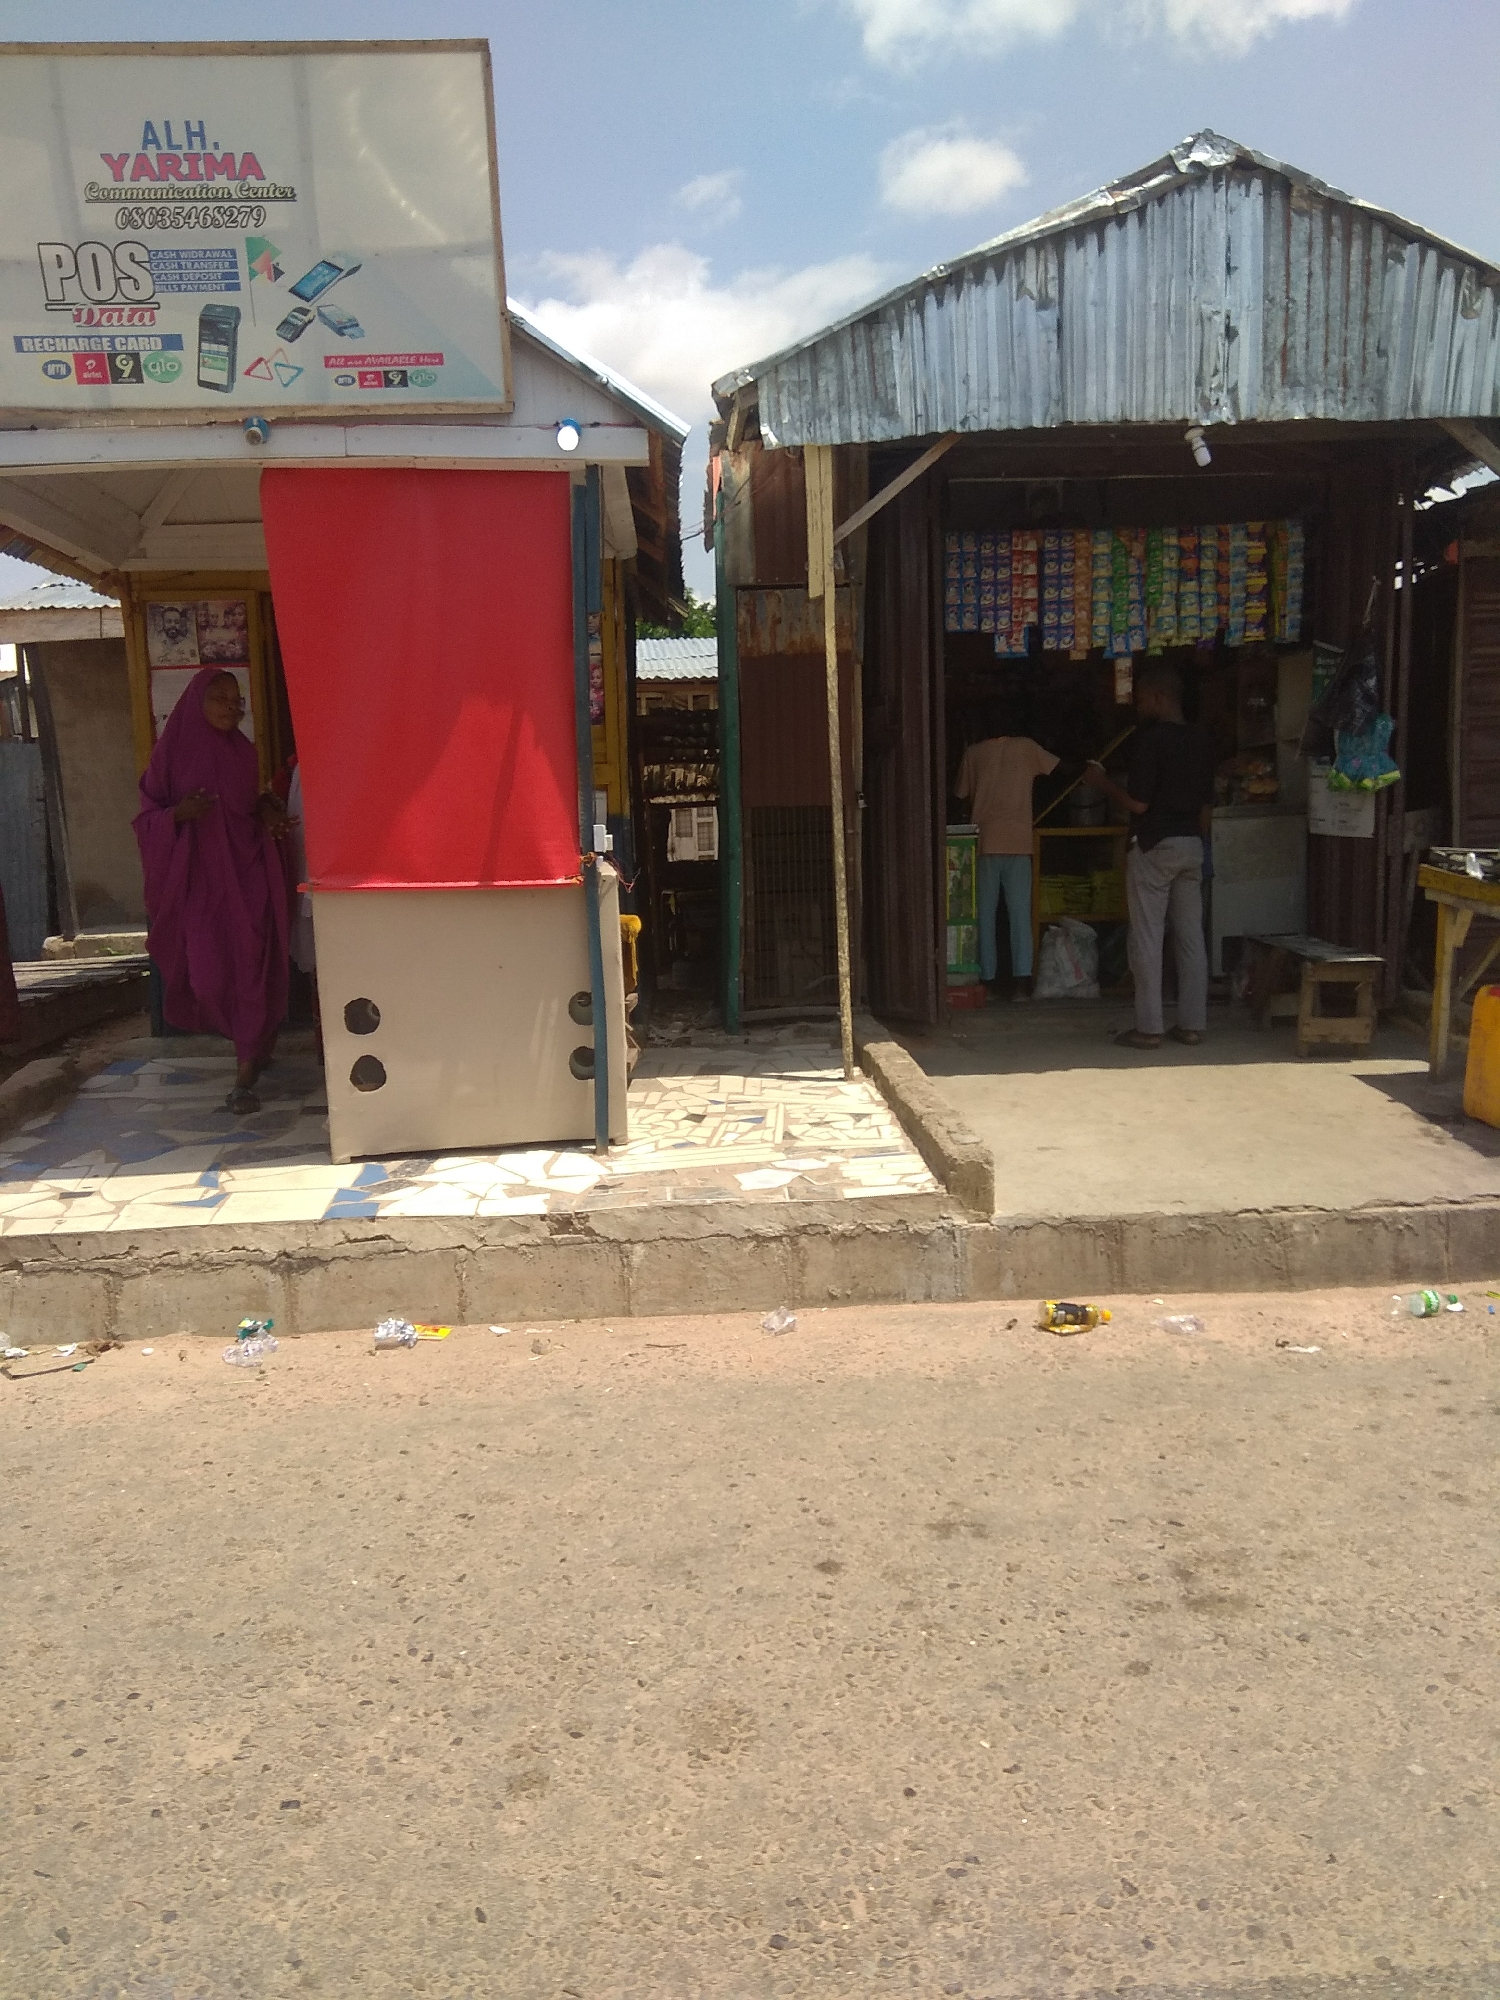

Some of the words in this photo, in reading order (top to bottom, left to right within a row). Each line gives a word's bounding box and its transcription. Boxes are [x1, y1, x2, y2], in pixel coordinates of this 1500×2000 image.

[141, 120, 220, 151] ALH.
[100, 152, 266, 182] YARIMA
[84, 181, 232, 200] Communication
[235, 181, 298, 200] Center
[115, 205, 266, 230] 08035468279
[151, 249, 178, 259] CASH
[180, 249, 233, 259] WIDRAWAL
[37, 240, 156, 302] POS
[151, 261, 179, 270] CASH
[181, 261, 231, 270] TRANSFER
[153, 273, 180, 281] CASH
[182, 272, 222, 281] DEPOSIT
[154, 284, 179, 292] BILLS
[181, 283, 226, 292] PAYMENT
[72, 303, 156, 327] Data
[22, 336, 111, 351] RECHARGE
[114, 336, 163, 351] CARD
[149, 358, 179, 376] glo
[364, 356, 416, 365] AVAILABLE
